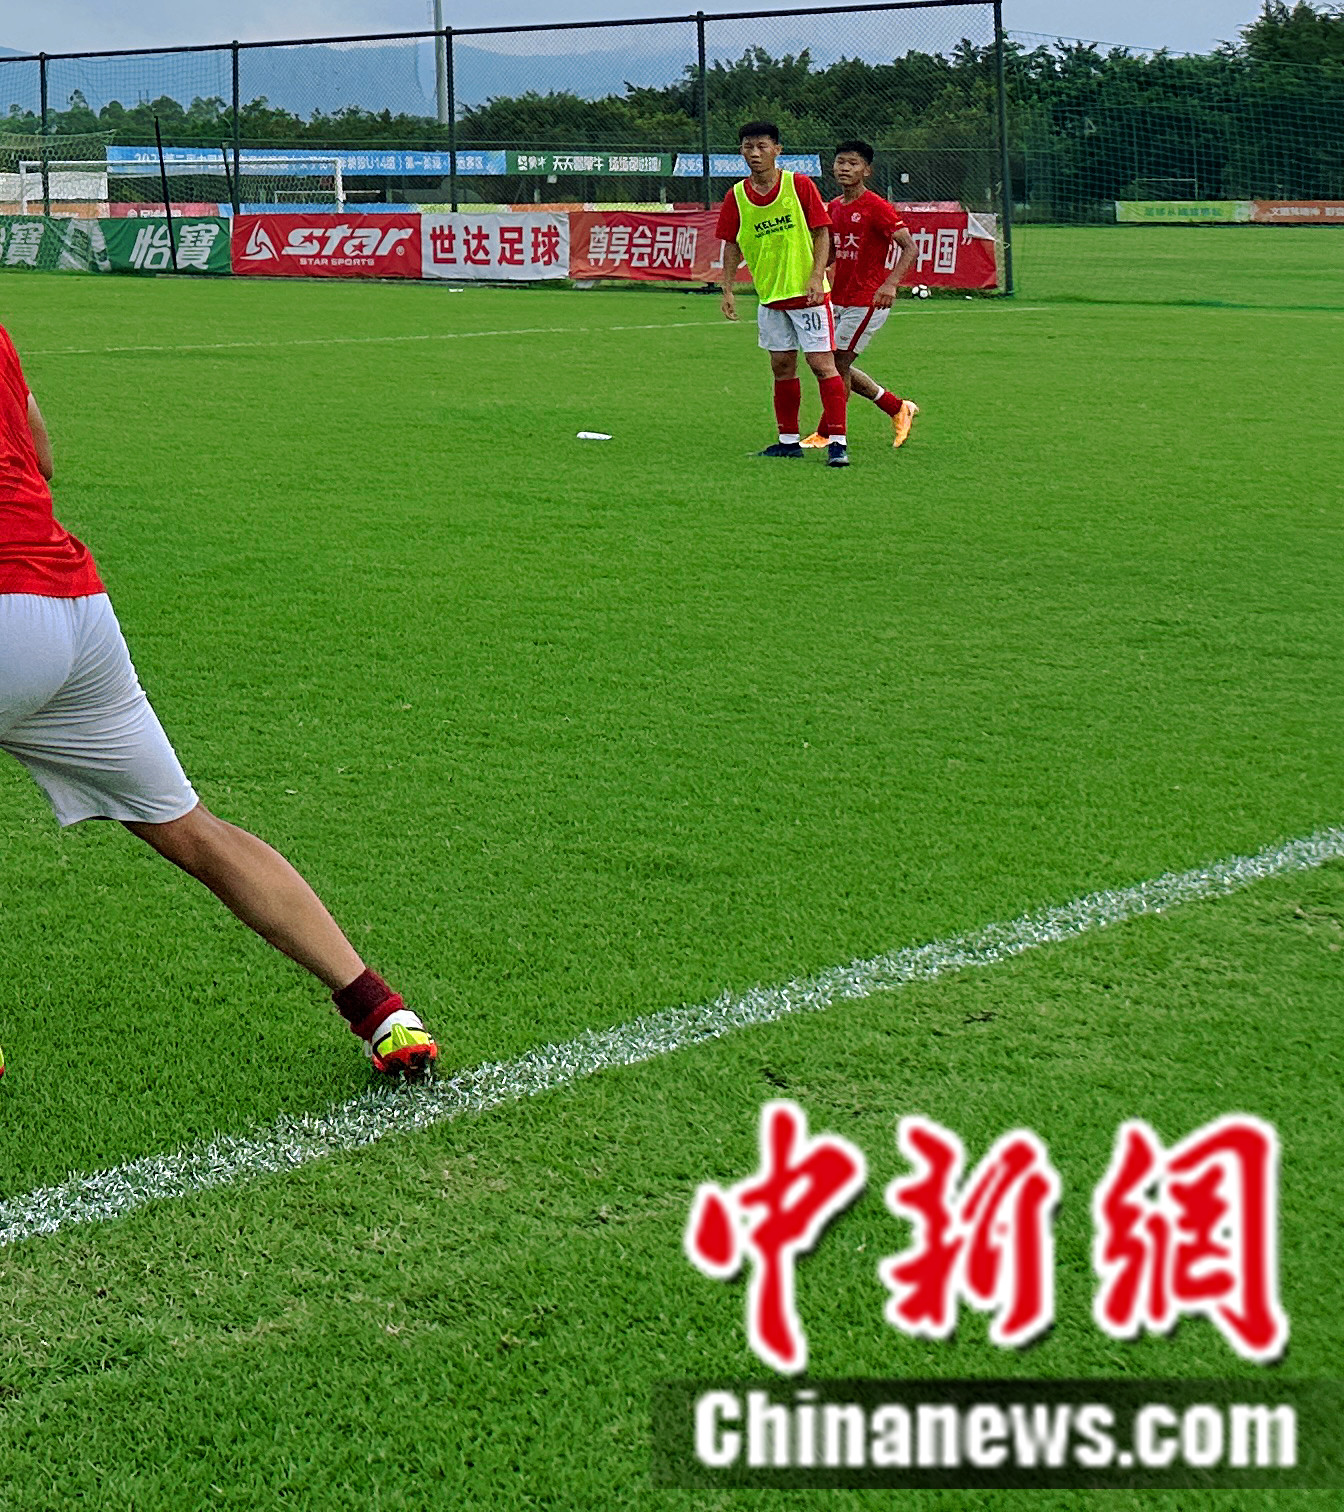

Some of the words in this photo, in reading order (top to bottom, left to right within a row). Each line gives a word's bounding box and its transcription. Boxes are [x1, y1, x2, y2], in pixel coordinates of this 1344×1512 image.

[753, 214, 793, 233] KELME
[128, 223, 220, 270] 怡寶
[430, 224, 560, 266] 世达足球
[587, 225, 698, 268] 尊享会员购
[299, 257, 329, 266] STAR
[331, 257, 375, 266] SPORTS
[801, 311, 822, 332] 30
